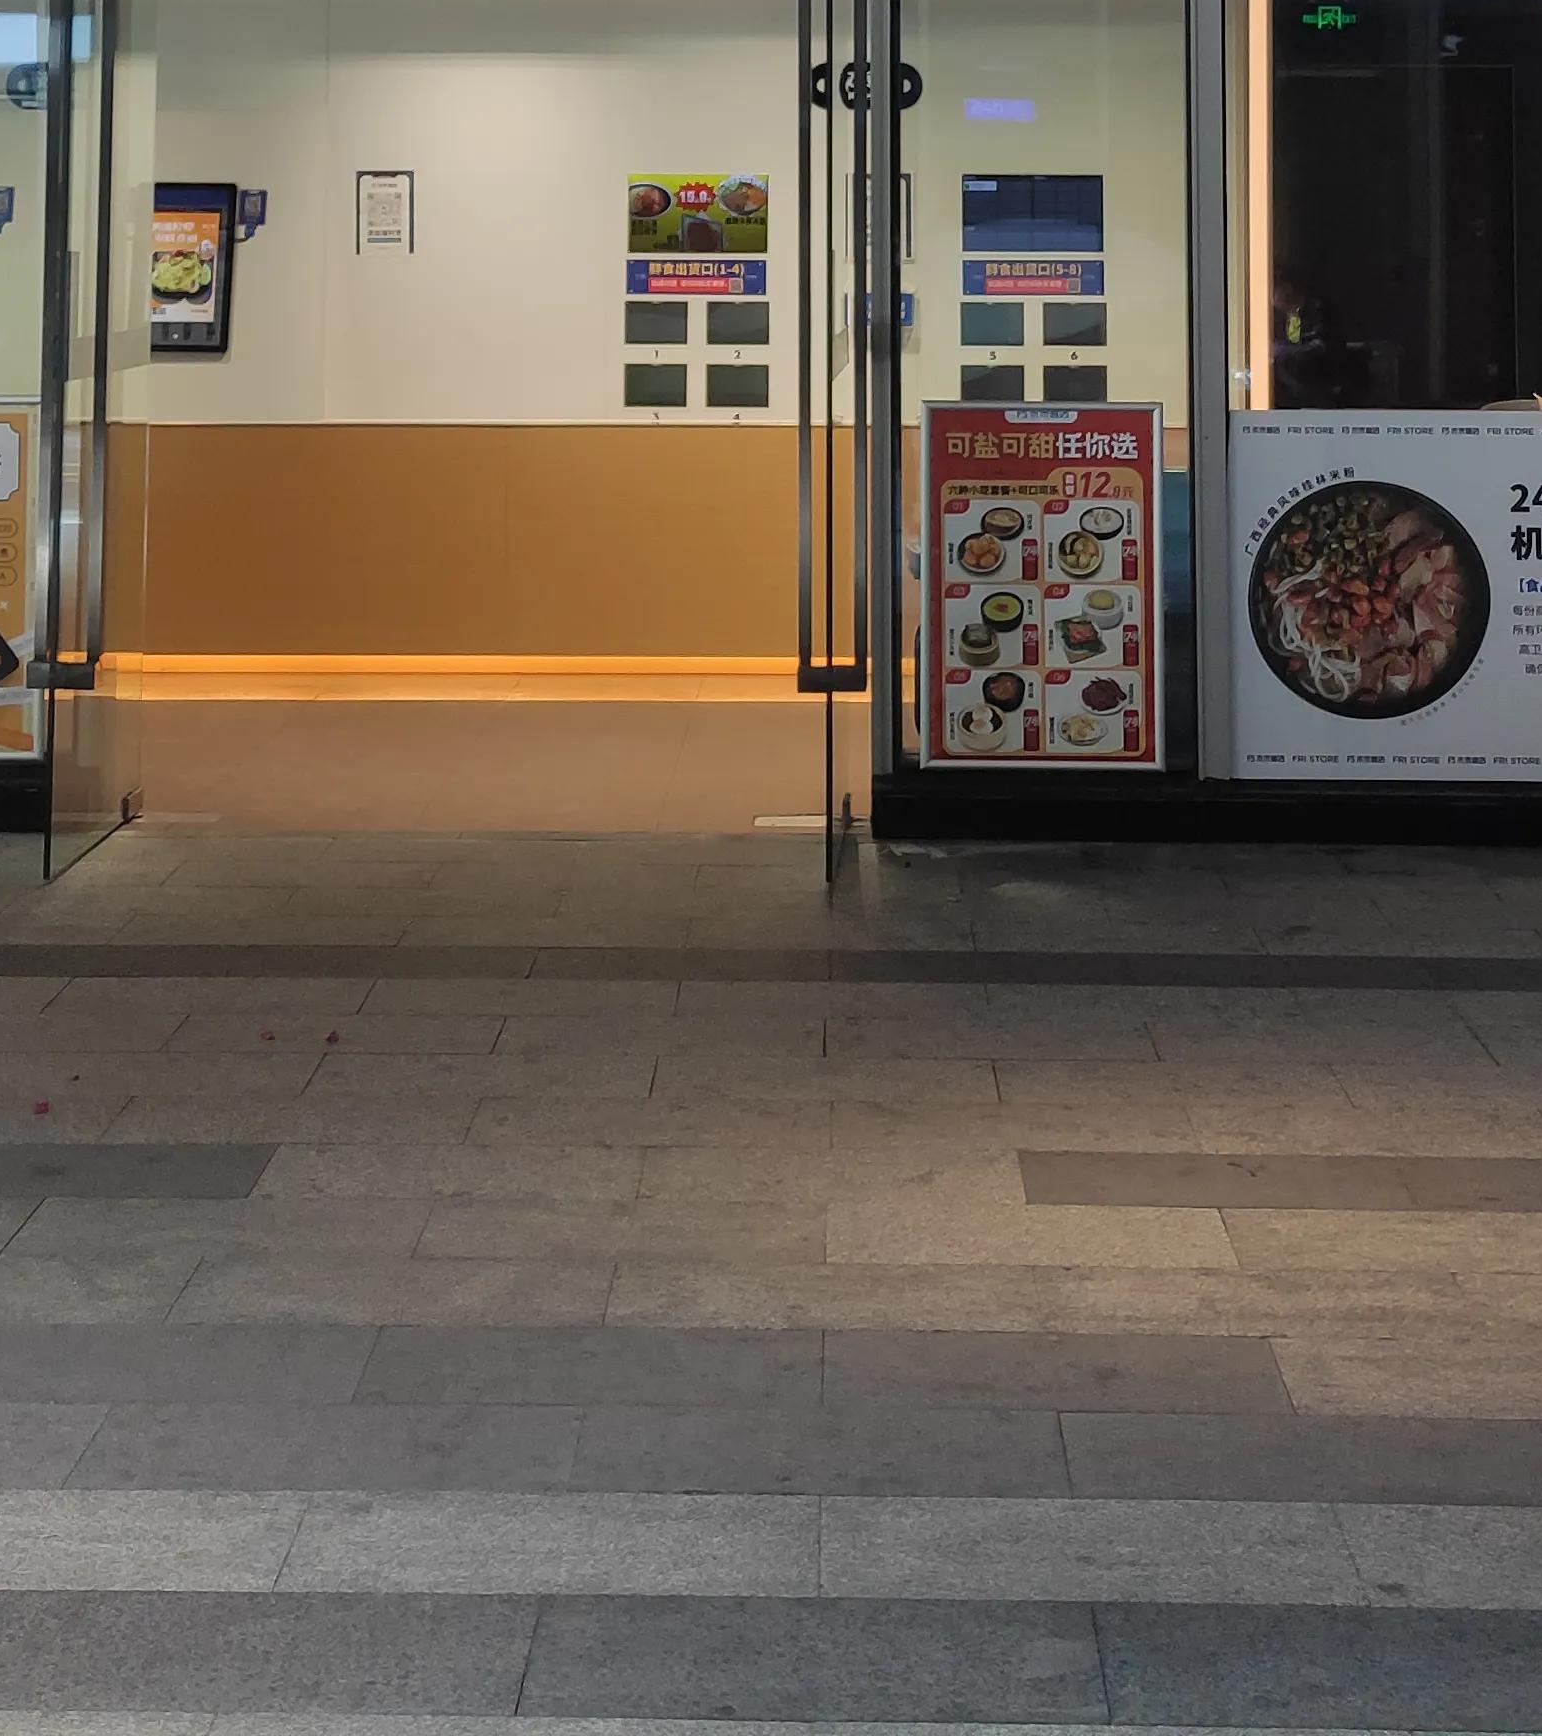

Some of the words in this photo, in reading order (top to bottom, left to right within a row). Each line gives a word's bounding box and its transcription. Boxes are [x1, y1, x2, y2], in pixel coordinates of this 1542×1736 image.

[945, 431, 1139, 460] 可盐可甜任你选
